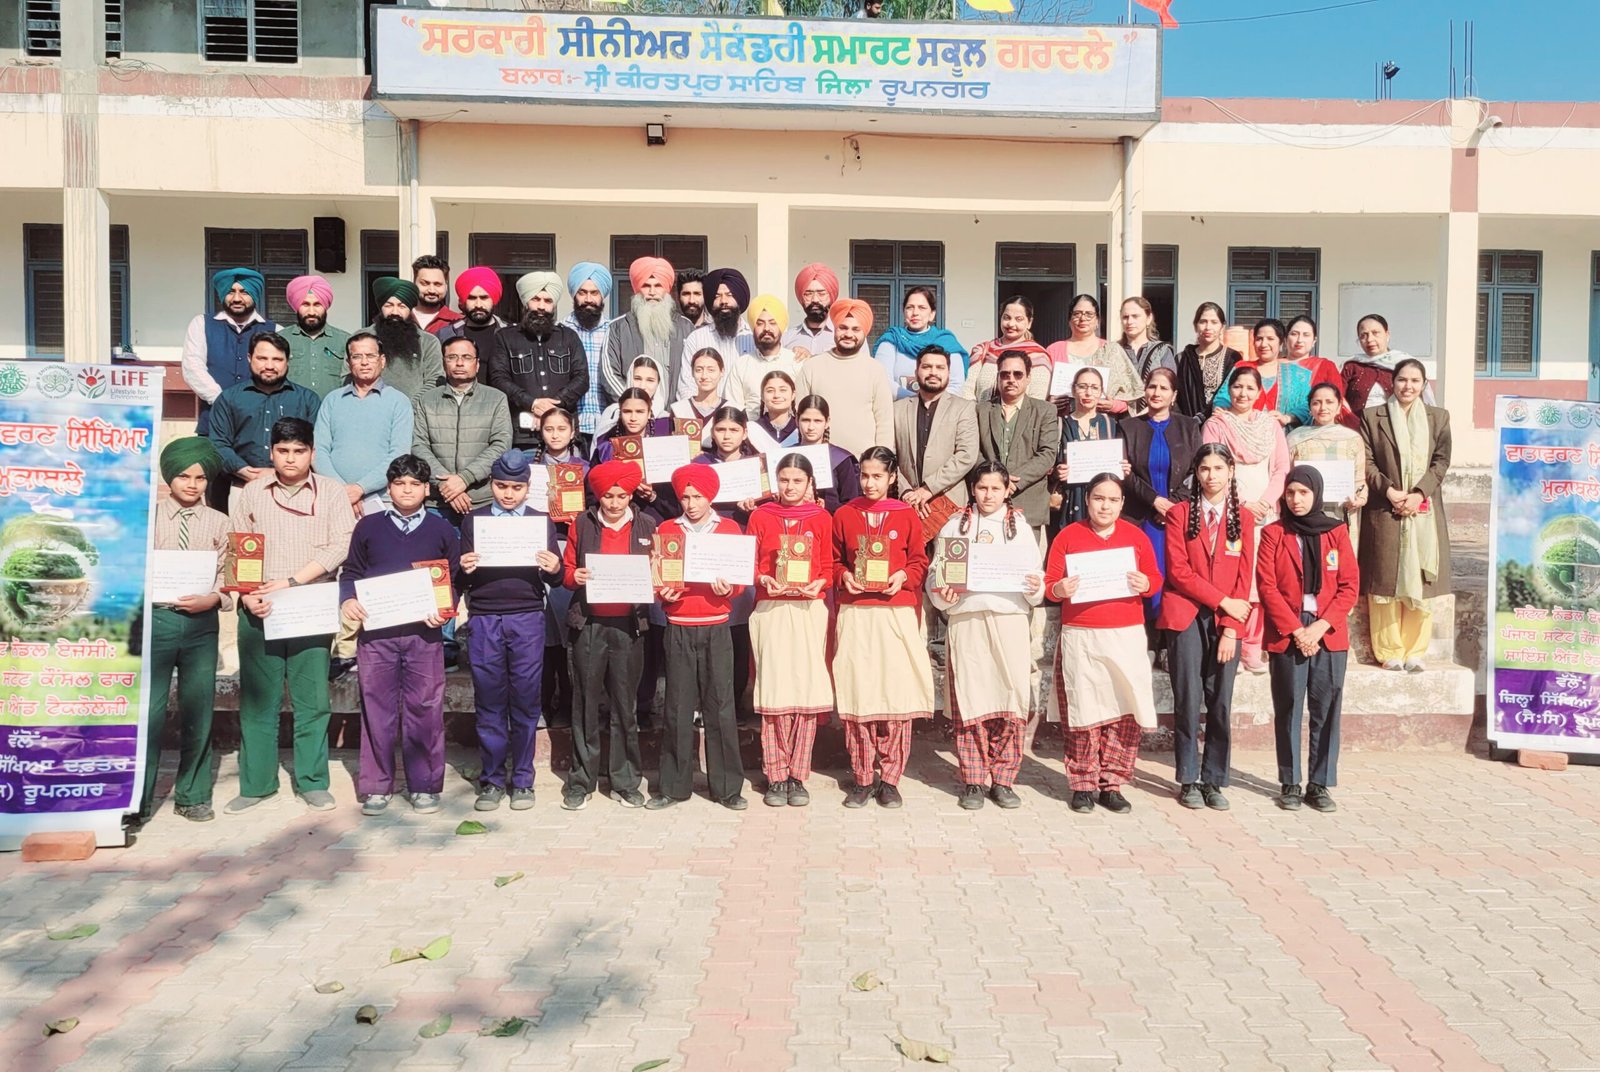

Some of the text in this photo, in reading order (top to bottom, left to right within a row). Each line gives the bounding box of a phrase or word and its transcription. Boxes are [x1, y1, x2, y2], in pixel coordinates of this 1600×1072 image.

[558, 16, 691, 60] ਸੀਨੀਅਰ
[811, 34, 911, 65] ਸਮਾਰਟ
[917, 37, 987, 77] ਸਕੂਲ
[728, 68, 806, 93] ਸਾਹਿਬ
[879, 79, 991, 106] ਰੂਪਨਗਰ
[110, 370, 149, 387] LiFE
[110, 388, 135, 396] Lifestyle
[67, 418, 147, 452] ਸਿੱਖਿਆ
[1505, 445, 1583, 463] ਵਾਤਾਵਰਣ
[99, 672, 135, 687] ਫਾਰ
[23, 783, 104, 805] ਰੂਪਨਗਰ
